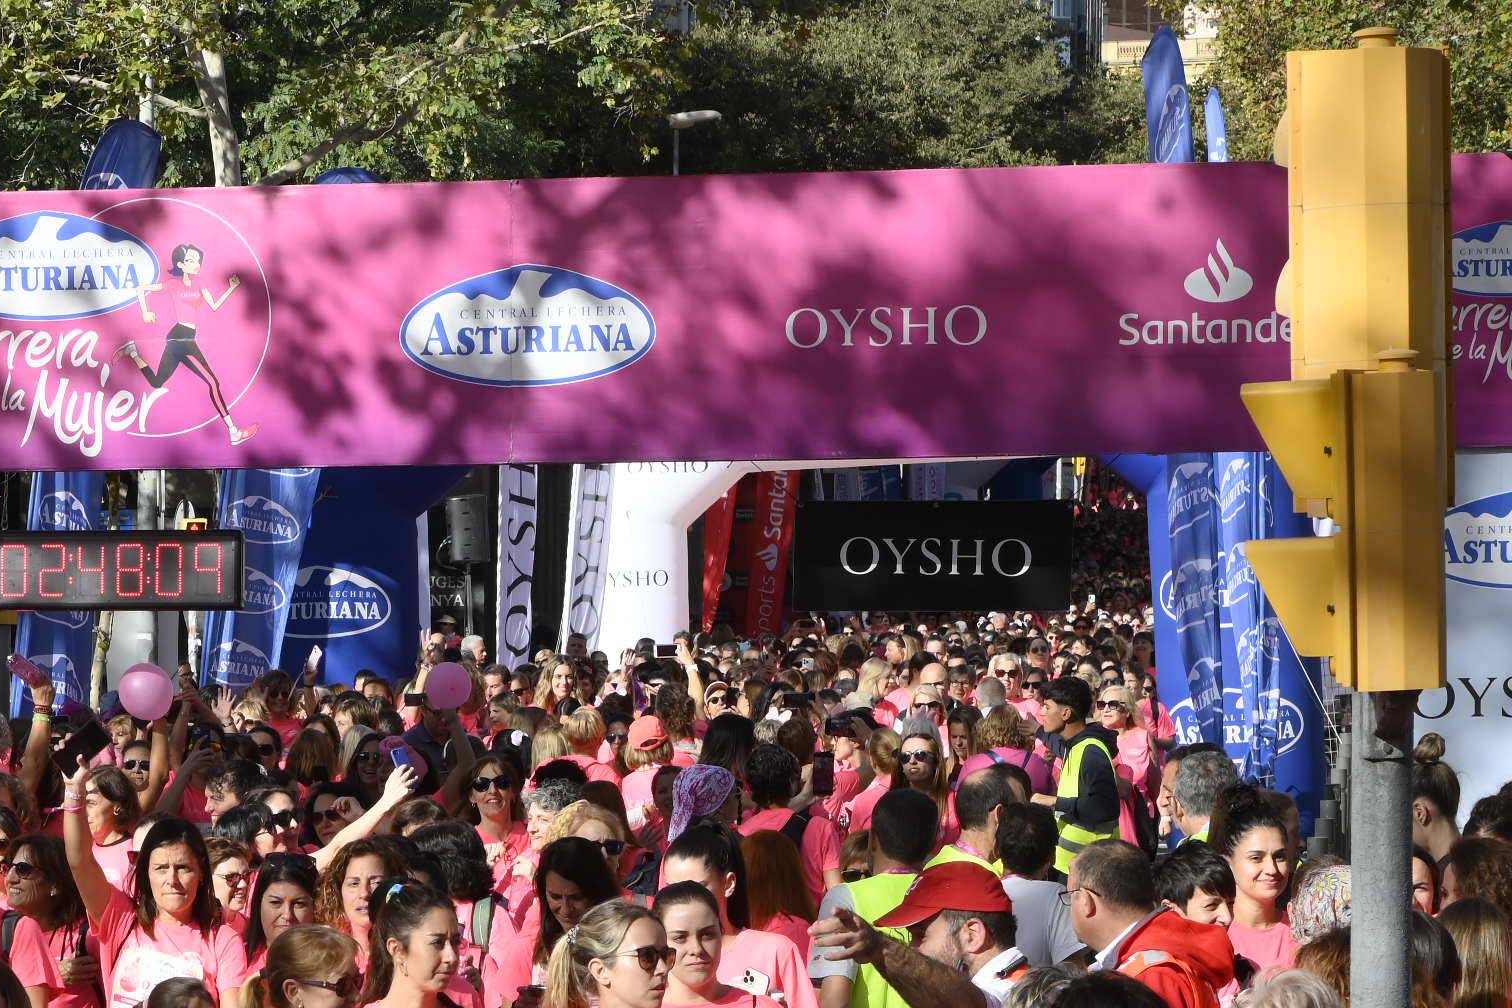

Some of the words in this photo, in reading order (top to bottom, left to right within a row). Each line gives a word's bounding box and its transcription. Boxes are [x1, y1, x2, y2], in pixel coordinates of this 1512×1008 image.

[62, 247, 135, 259] LECHERA
[460, 307, 538, 319] CENTRAL
[547, 305, 627, 318] LECHERA
[786, 304, 988, 349] OYSHO
[1119, 312, 1291, 346] Santande
[420, 312, 636, 356] ASTURIANA
[1469, 333, 1486, 360] la
[1, 371, 26, 412] la
[20, 364, 169, 458] Mujer
[505, 463, 536, 657] OYSH
[569, 463, 608, 640] OYSH
[839, 536, 1033, 577] OYSHO
[0, 544, 223, 597] 02:48:09
[609, 570, 670, 588] YSHO
[290, 601, 382, 620] TURIANA
[294, 591, 322, 599] NTRAL
[329, 590, 377, 599] LECHERA
